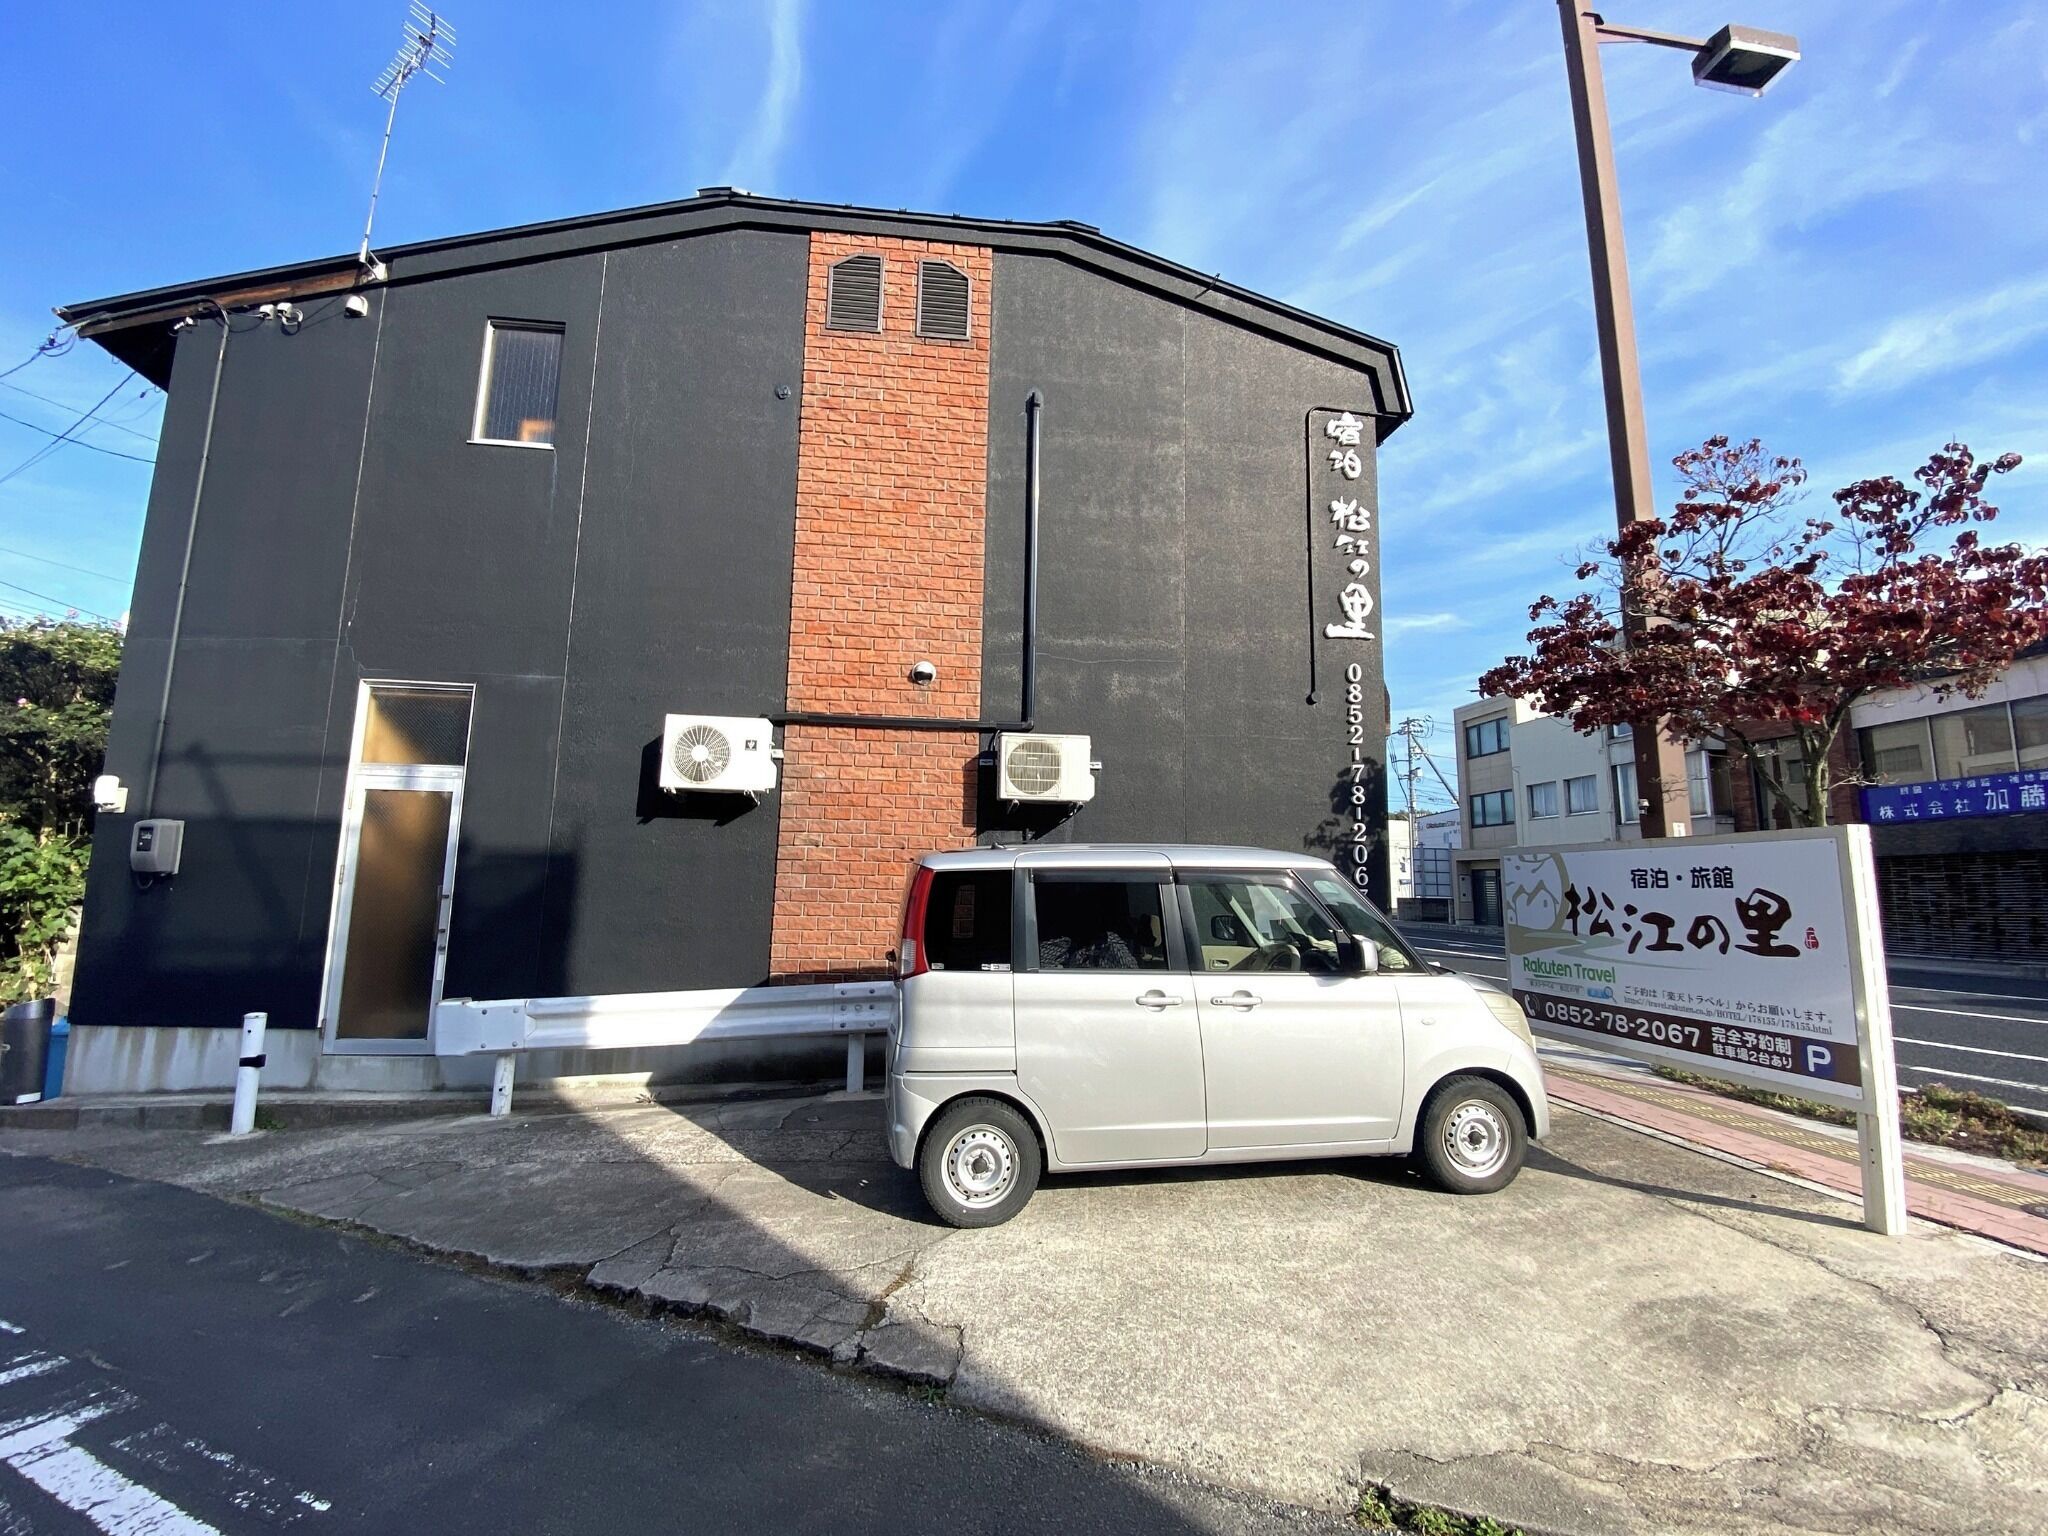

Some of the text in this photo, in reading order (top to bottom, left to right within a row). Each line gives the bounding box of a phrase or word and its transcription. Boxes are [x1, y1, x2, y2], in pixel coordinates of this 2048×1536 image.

[1325, 412, 1375, 639] 宿泊 松江の里
[1347, 663, 1369, 897] 0852-78-206
[1630, 866, 1734, 889] 宿泊・旅館
[1565, 888, 1801, 957] 松江の里
[1522, 956, 1616, 983] Rakuten Travel
[1545, 1001, 1701, 1048] 0852-78-2067
[1711, 1026, 1792, 1055] 完全予約制
[1712, 1043, 1793, 1069] 駐車場2台あり
[1806, 1045, 1832, 1072] P
